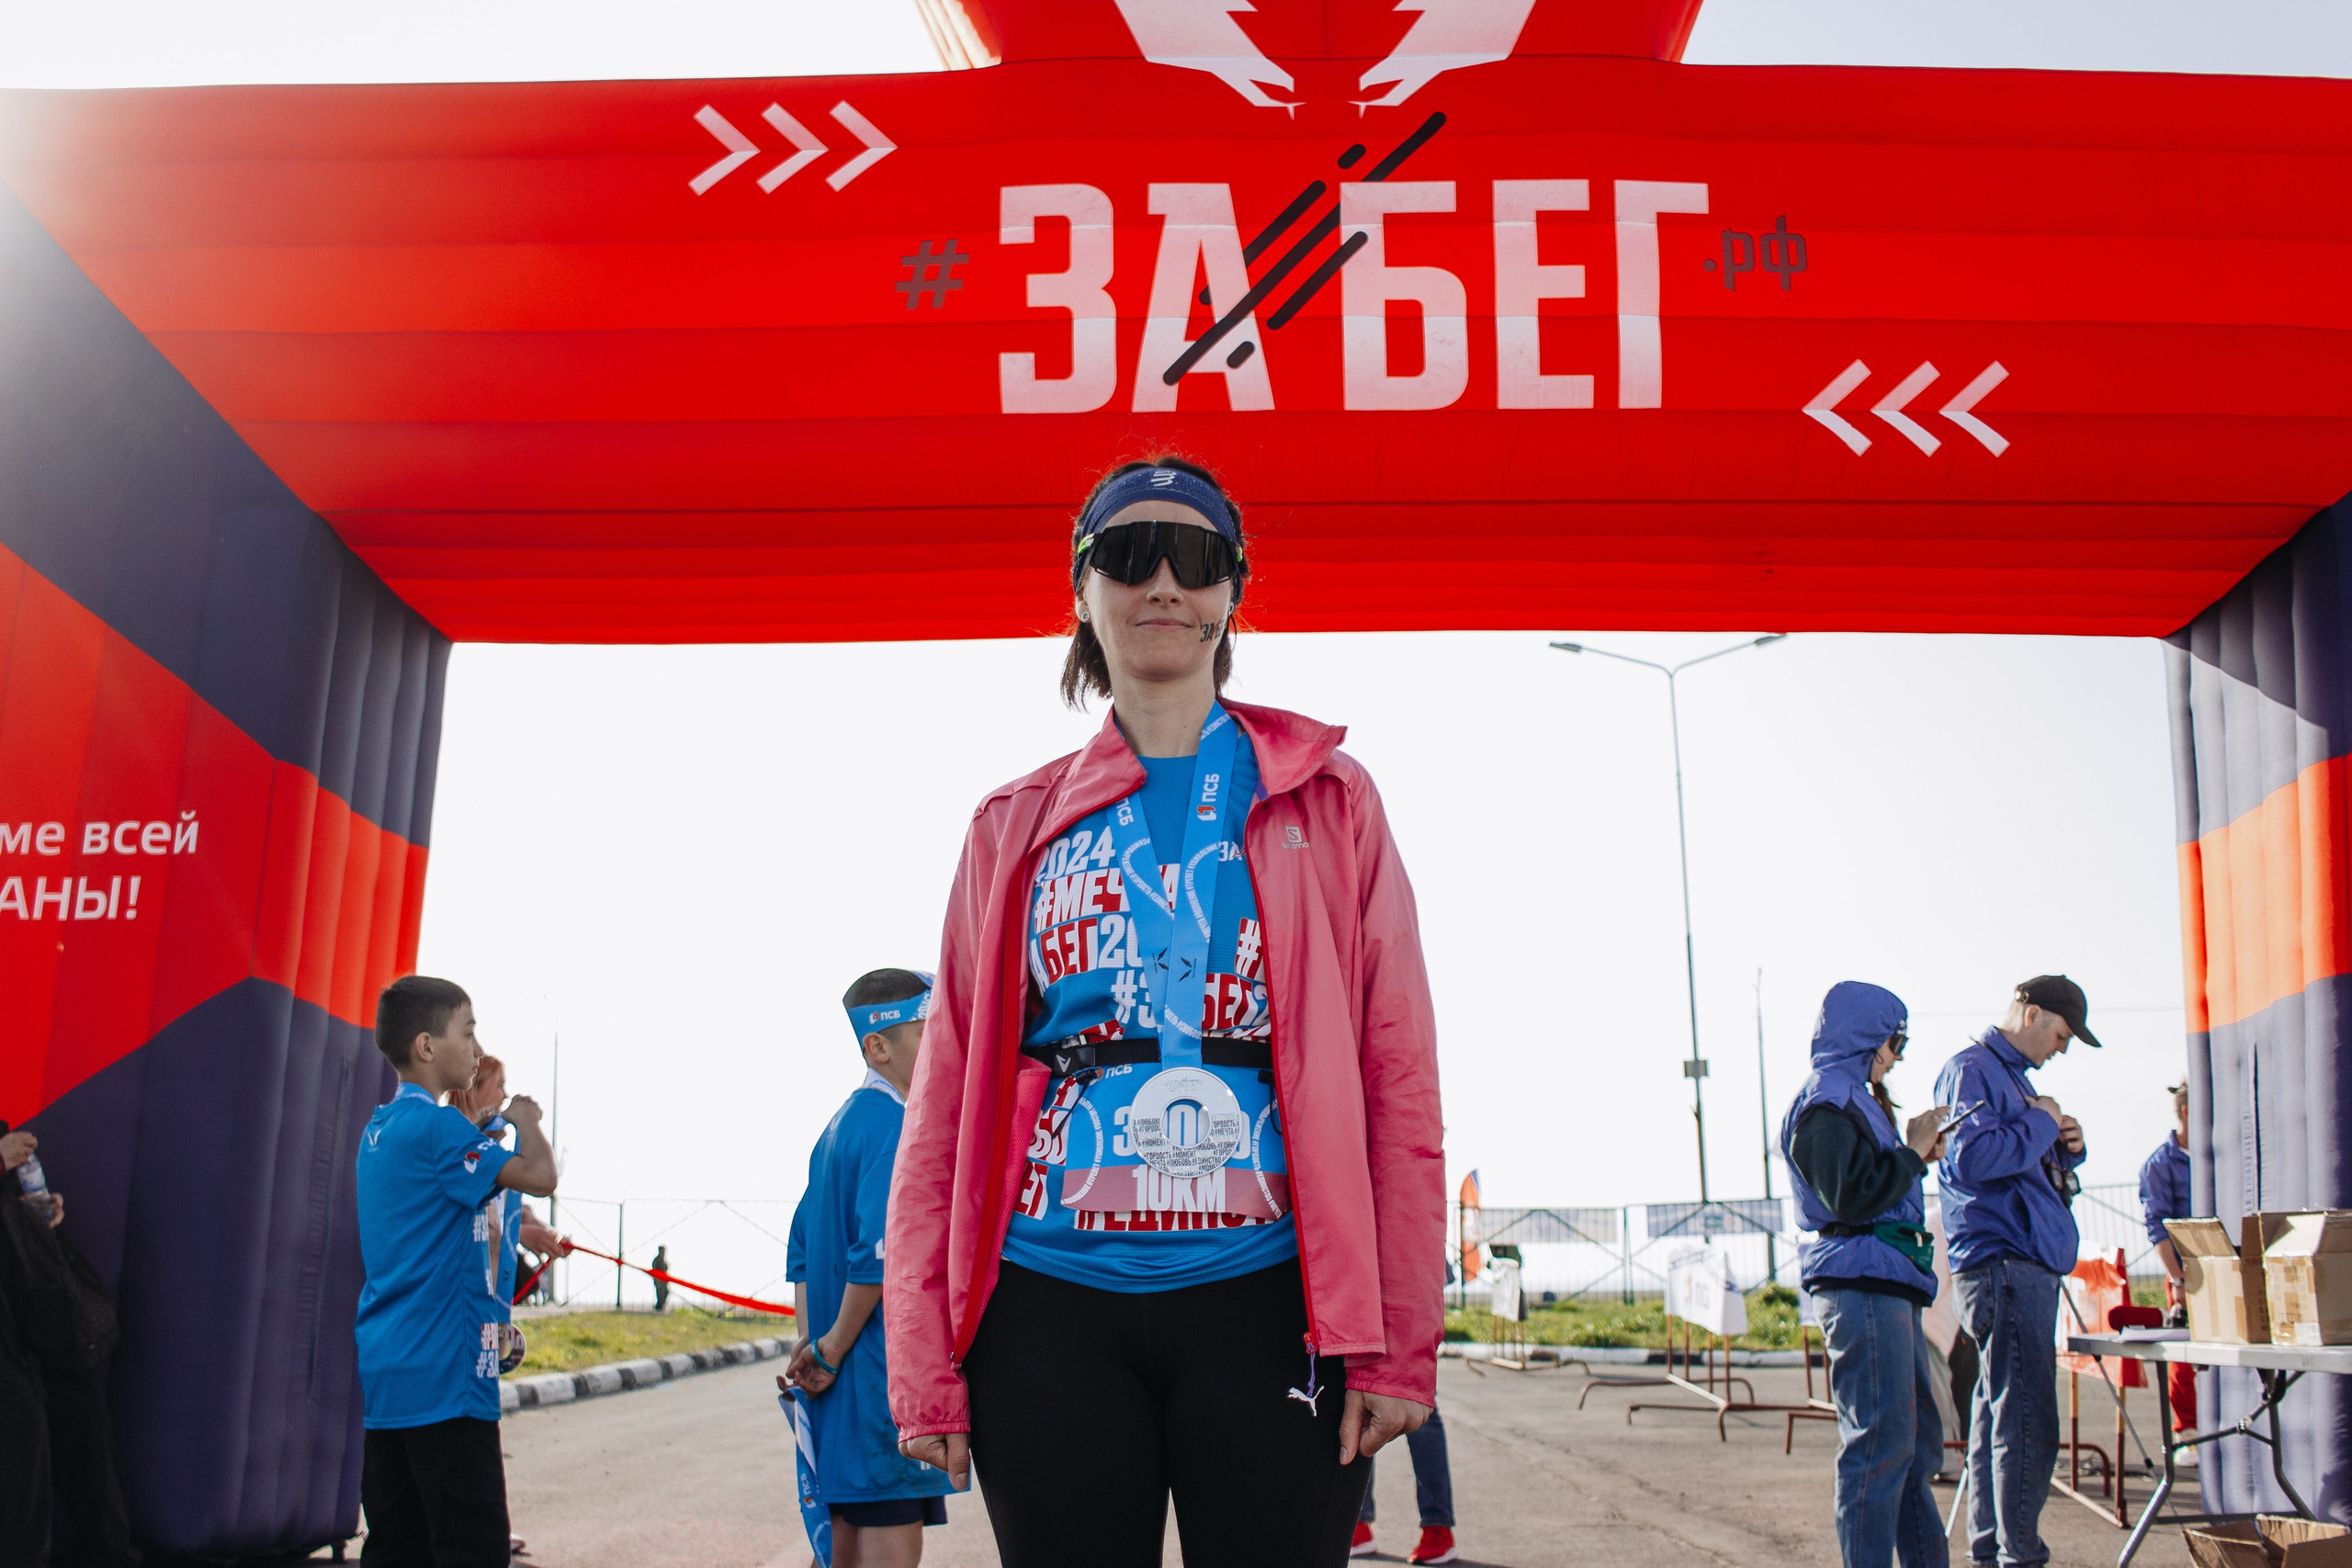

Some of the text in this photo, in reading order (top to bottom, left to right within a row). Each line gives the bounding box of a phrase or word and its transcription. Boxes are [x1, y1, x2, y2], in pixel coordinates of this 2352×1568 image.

[1202, 773, 1220, 803] ПСБ
[82, 809, 199, 855] всей
[0, 875, 141, 921] АНЫ!
[880, 1010, 901, 1021] ПСБ
[1105, 1064, 1133, 1078] ПСБ
